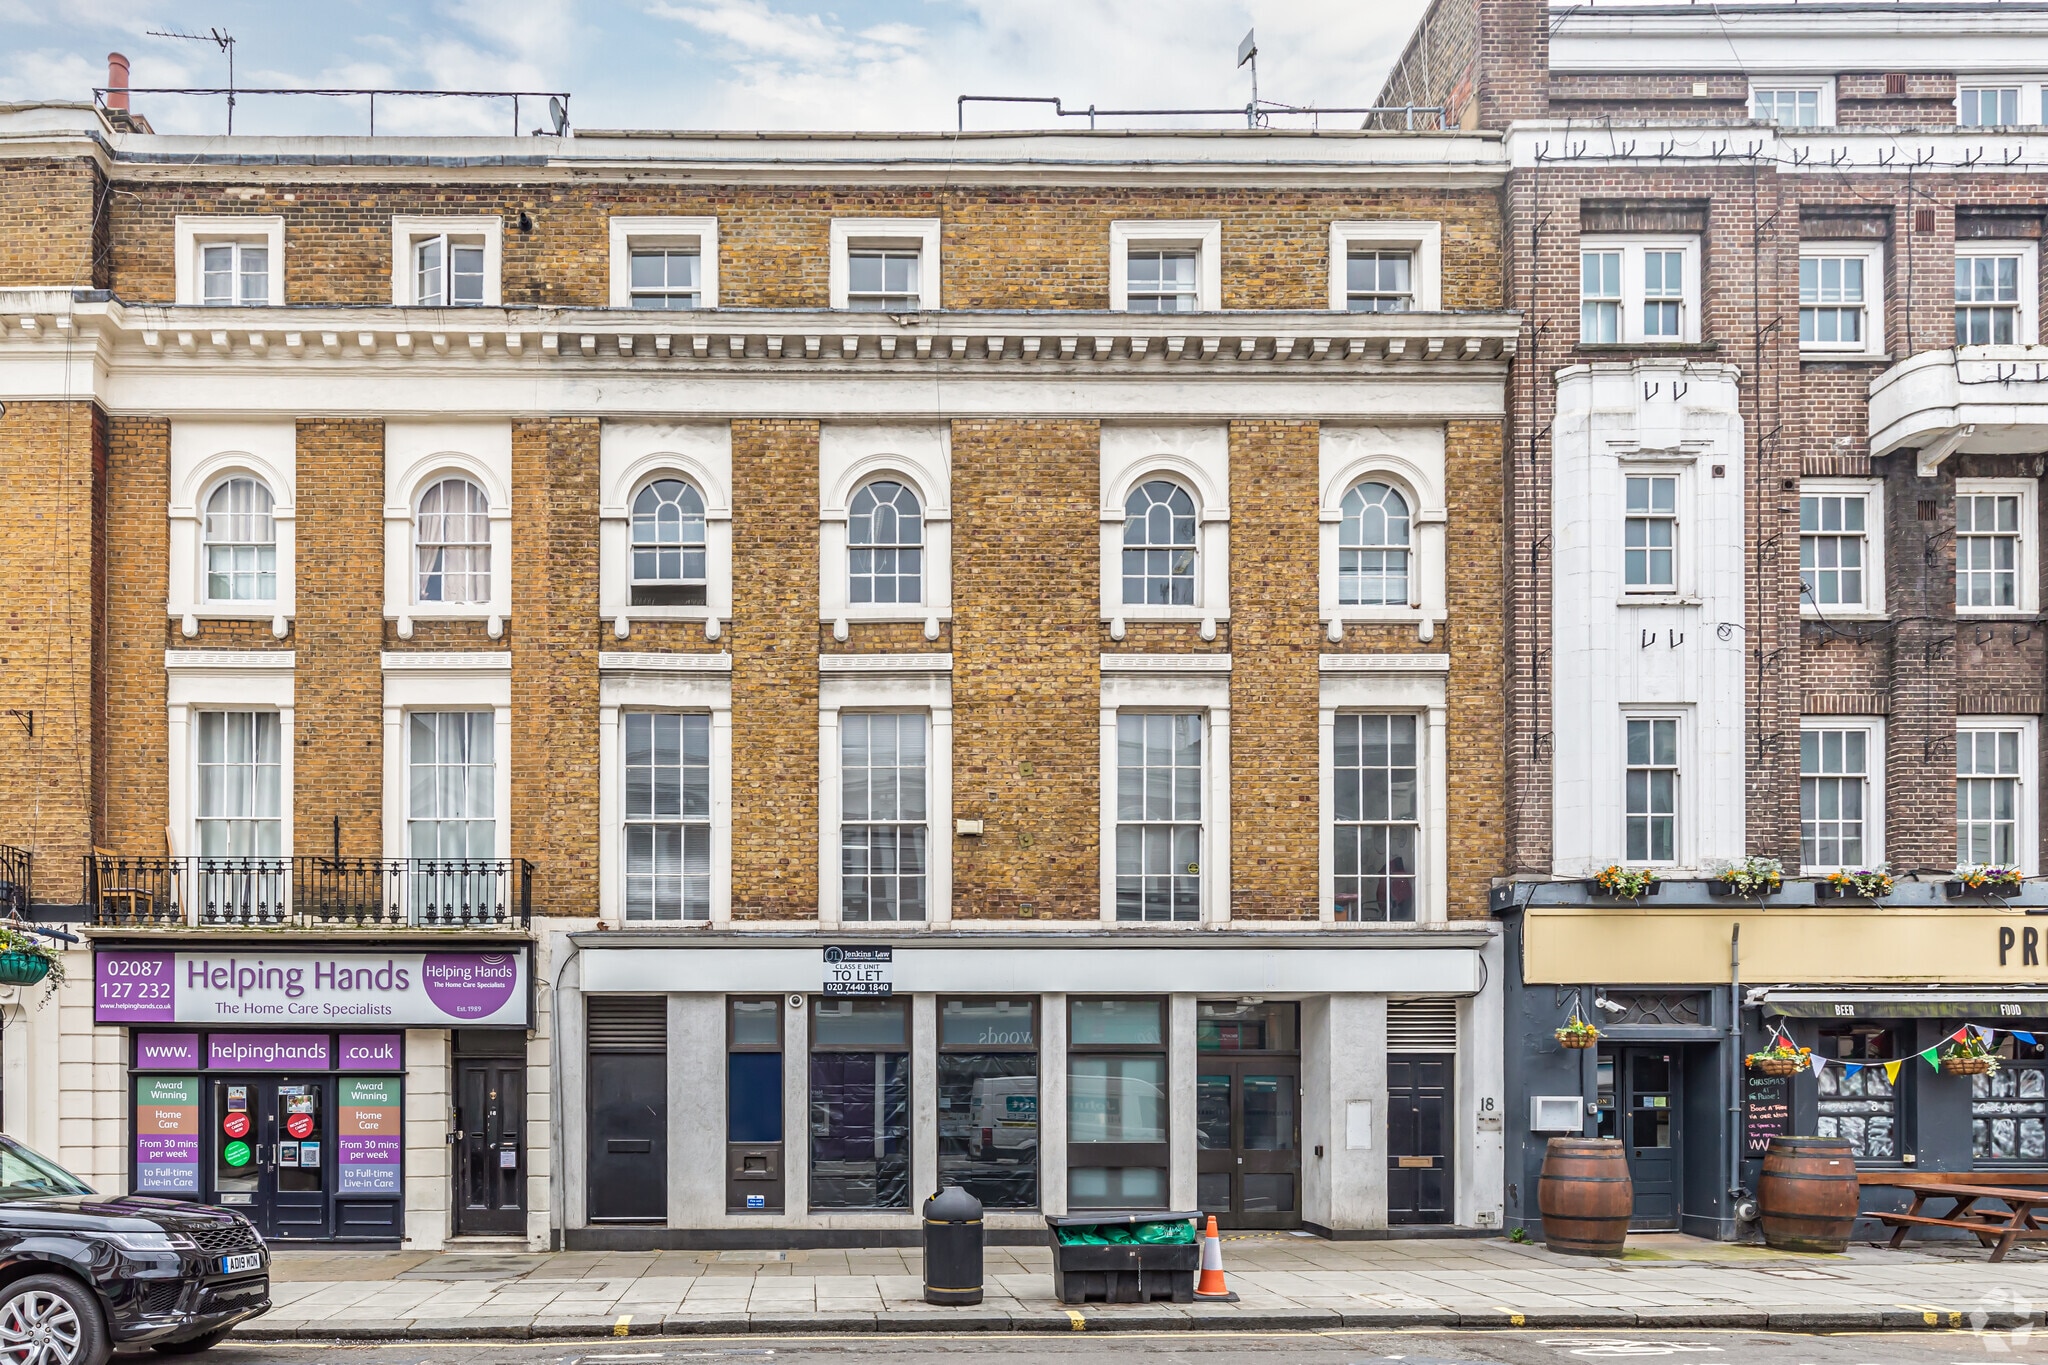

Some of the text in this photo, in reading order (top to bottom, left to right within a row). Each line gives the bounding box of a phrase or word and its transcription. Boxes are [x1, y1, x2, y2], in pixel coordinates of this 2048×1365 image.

[1999, 926, 2048, 966] PR
[844, 950, 890, 958] Jenkins Law
[107, 960, 163, 977] 02087
[426, 965, 513, 980] Helping Hands
[187, 958, 410, 998] Helping Hands
[832, 970, 883, 981] TO LET
[100, 982, 171, 999] 127 232
[827, 983, 889, 991] 020 7440 1840
[100, 1002, 171, 1011] www.helpinghands.co.uk
[214, 1002, 392, 1017] The Home Care Specialists
[1834, 1004, 2022, 1016] BEER FOOD
[145, 1043, 394, 1062] www. helpinghands .co.uk
[155, 1081, 183, 1089] Award
[355, 1082, 383, 1090] Award
[150, 1090, 187, 1101] Winning
[351, 1092, 388, 1102] Winning
[1481, 1097, 1495, 1112] 18
[155, 1110, 182, 1119] Home
[355, 1111, 382, 1120] Home
[158, 1120, 179, 1129] Care
[358, 1121, 379, 1130] Care
[139, 1139, 198, 1148] From 30 mins
[340, 1140, 399, 1149] From 30 mins
[149, 1149, 188, 1160] per week
[350, 1150, 389, 1161] per week
[144, 1168, 193, 1177] to Full-time
[345, 1169, 394, 1178] to Full-time
[143, 1178, 193, 1187] Live-in Care
[344, 1179, 394, 1188] Live-in Care
